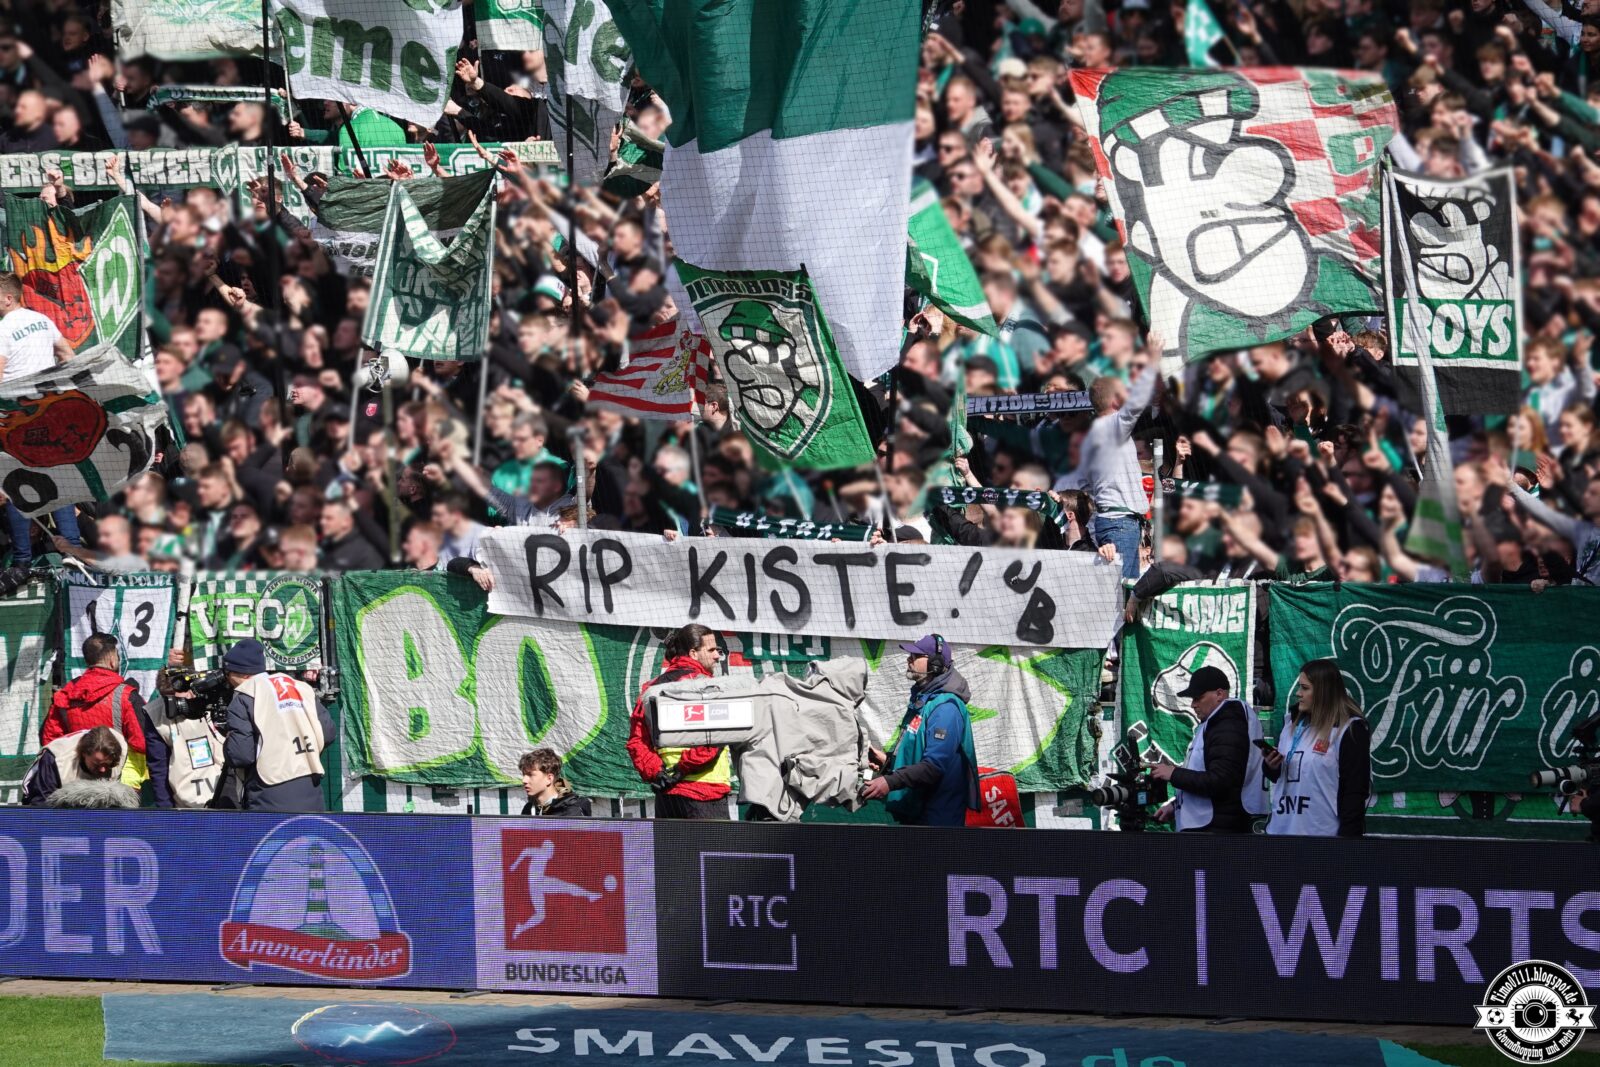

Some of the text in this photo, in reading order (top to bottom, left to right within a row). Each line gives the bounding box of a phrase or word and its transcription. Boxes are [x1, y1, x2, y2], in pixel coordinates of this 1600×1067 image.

[1401, 303, 1513, 357] BOYS
[128, 574, 174, 587] POLICE
[525, 534, 632, 616] RIP
[190, 598, 285, 639] VEC
[1182, 592, 1247, 634] RAUS
[985, 785, 1017, 828] SAF
[728, 894, 788, 928] RTC
[947, 874, 1150, 973] RTC
[228, 928, 403, 970] Ammerländer
[505, 962, 628, 985] BUNDESLIGA
[507, 1027, 1047, 1067] SMAVESTO
